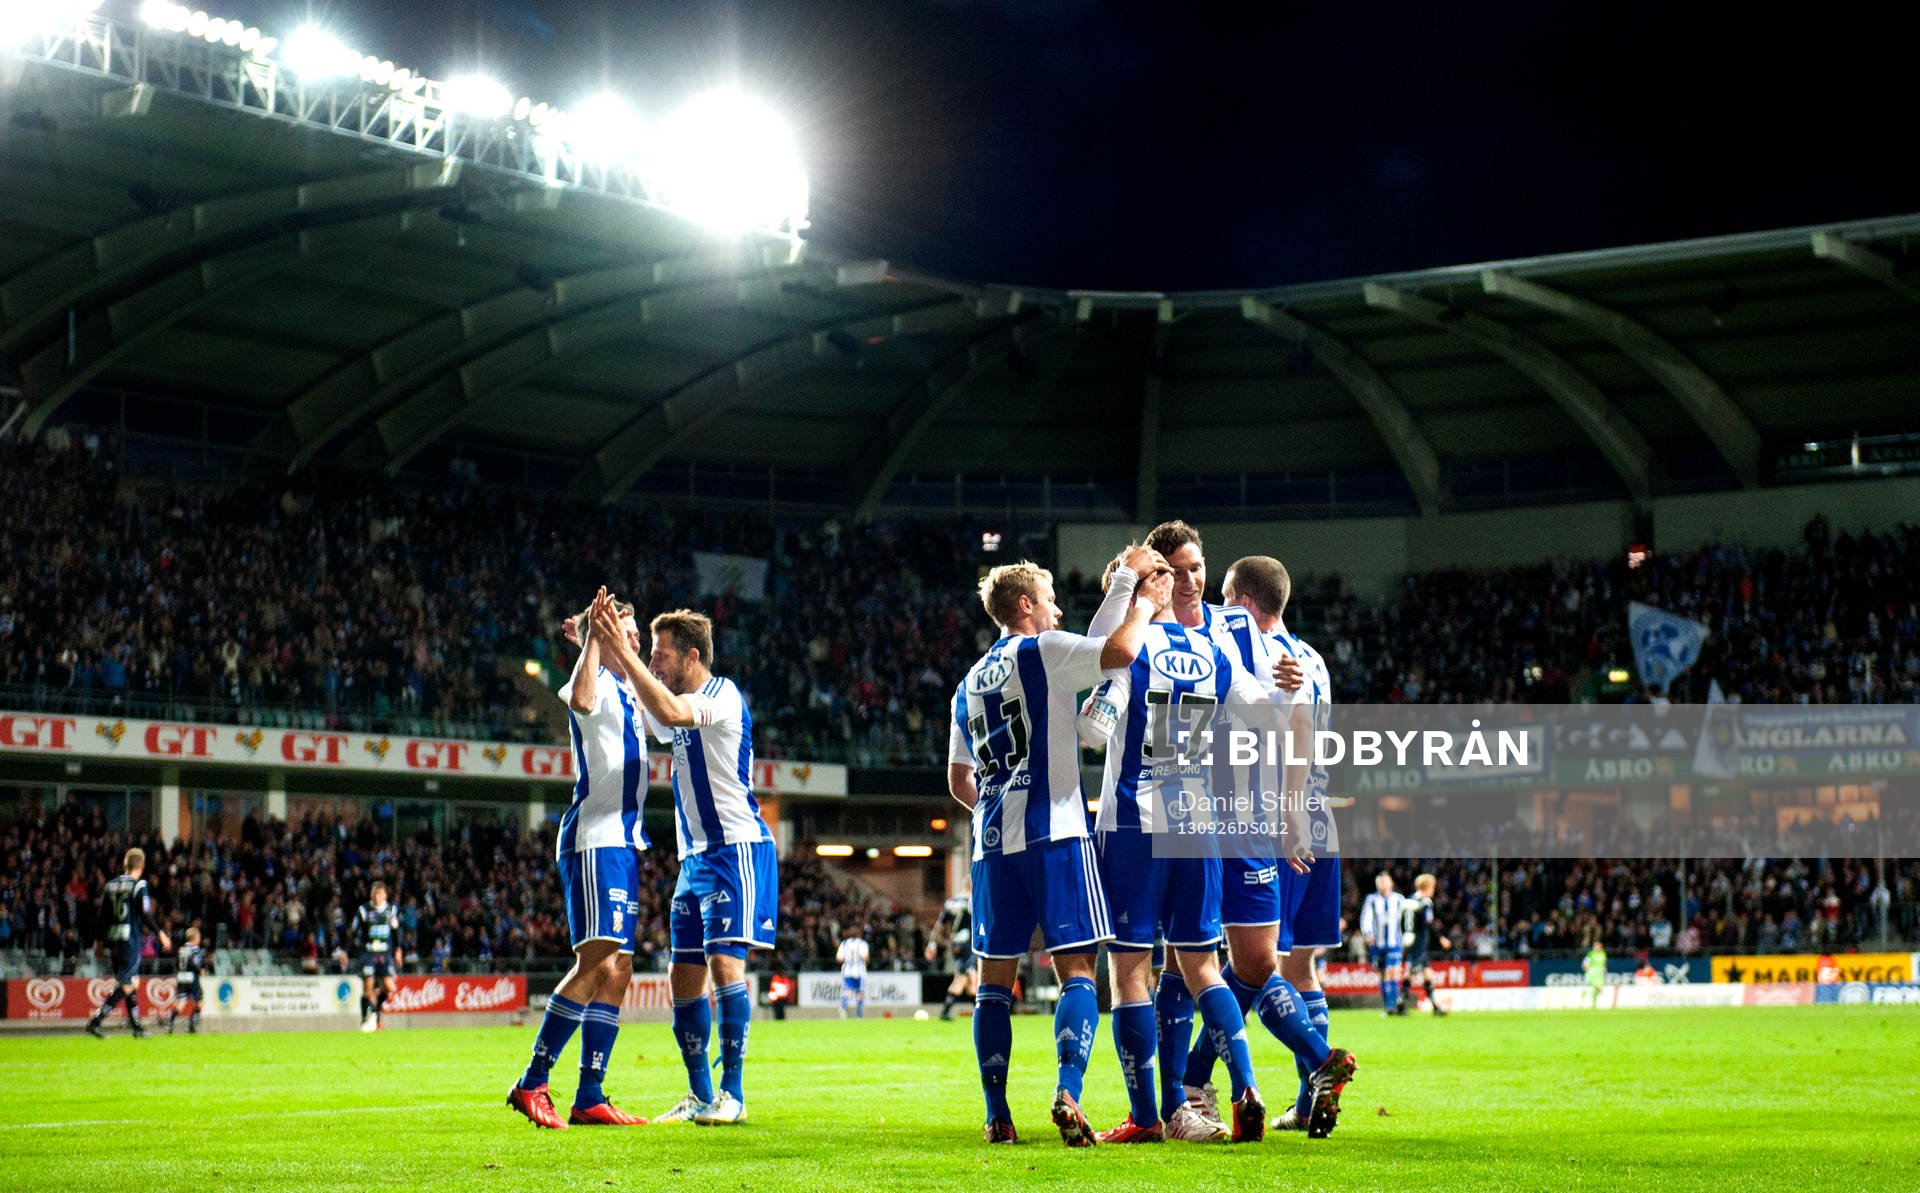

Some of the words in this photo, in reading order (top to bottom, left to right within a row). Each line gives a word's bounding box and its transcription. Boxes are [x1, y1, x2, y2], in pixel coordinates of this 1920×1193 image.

[976, 664, 1006, 690] KIA
[1164, 655, 1203, 676] KIA
[0, 716, 76, 749] GT
[144, 723, 217, 757] GT
[1141, 689, 1218, 761] 17
[280, 732, 349, 764] GT
[405, 740, 468, 772] GT
[1740, 754, 1775, 774] RO
[721, 917, 732, 933] 7
[455, 977, 516, 1010] Estrella
